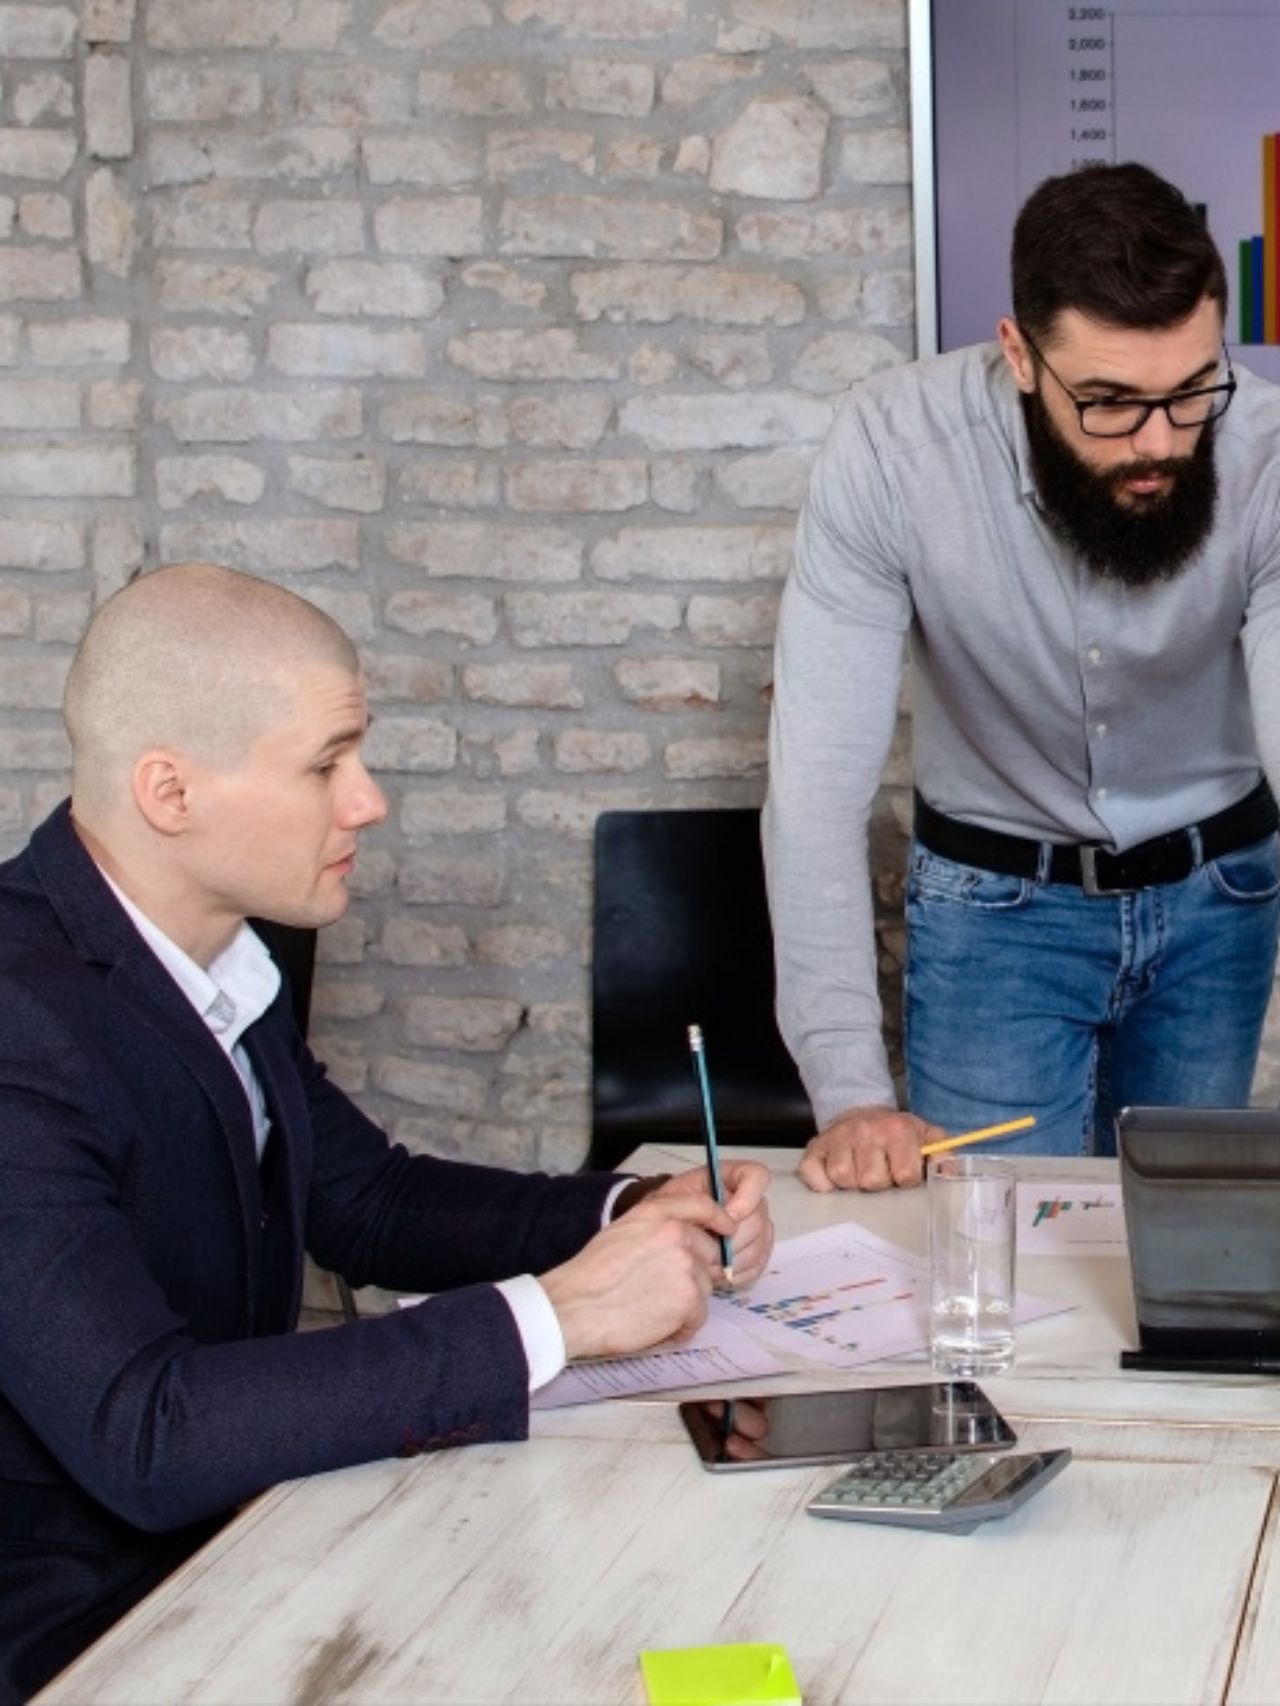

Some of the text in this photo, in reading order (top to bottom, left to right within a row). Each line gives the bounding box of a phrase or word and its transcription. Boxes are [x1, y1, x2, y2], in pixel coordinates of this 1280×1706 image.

[1068, 38, 1106, 51] 2,000
[1070, 69, 1106, 81] 1,800
[1070, 99, 1106, 112] 1,600
[1071, 128, 1106, 142] 1,400
